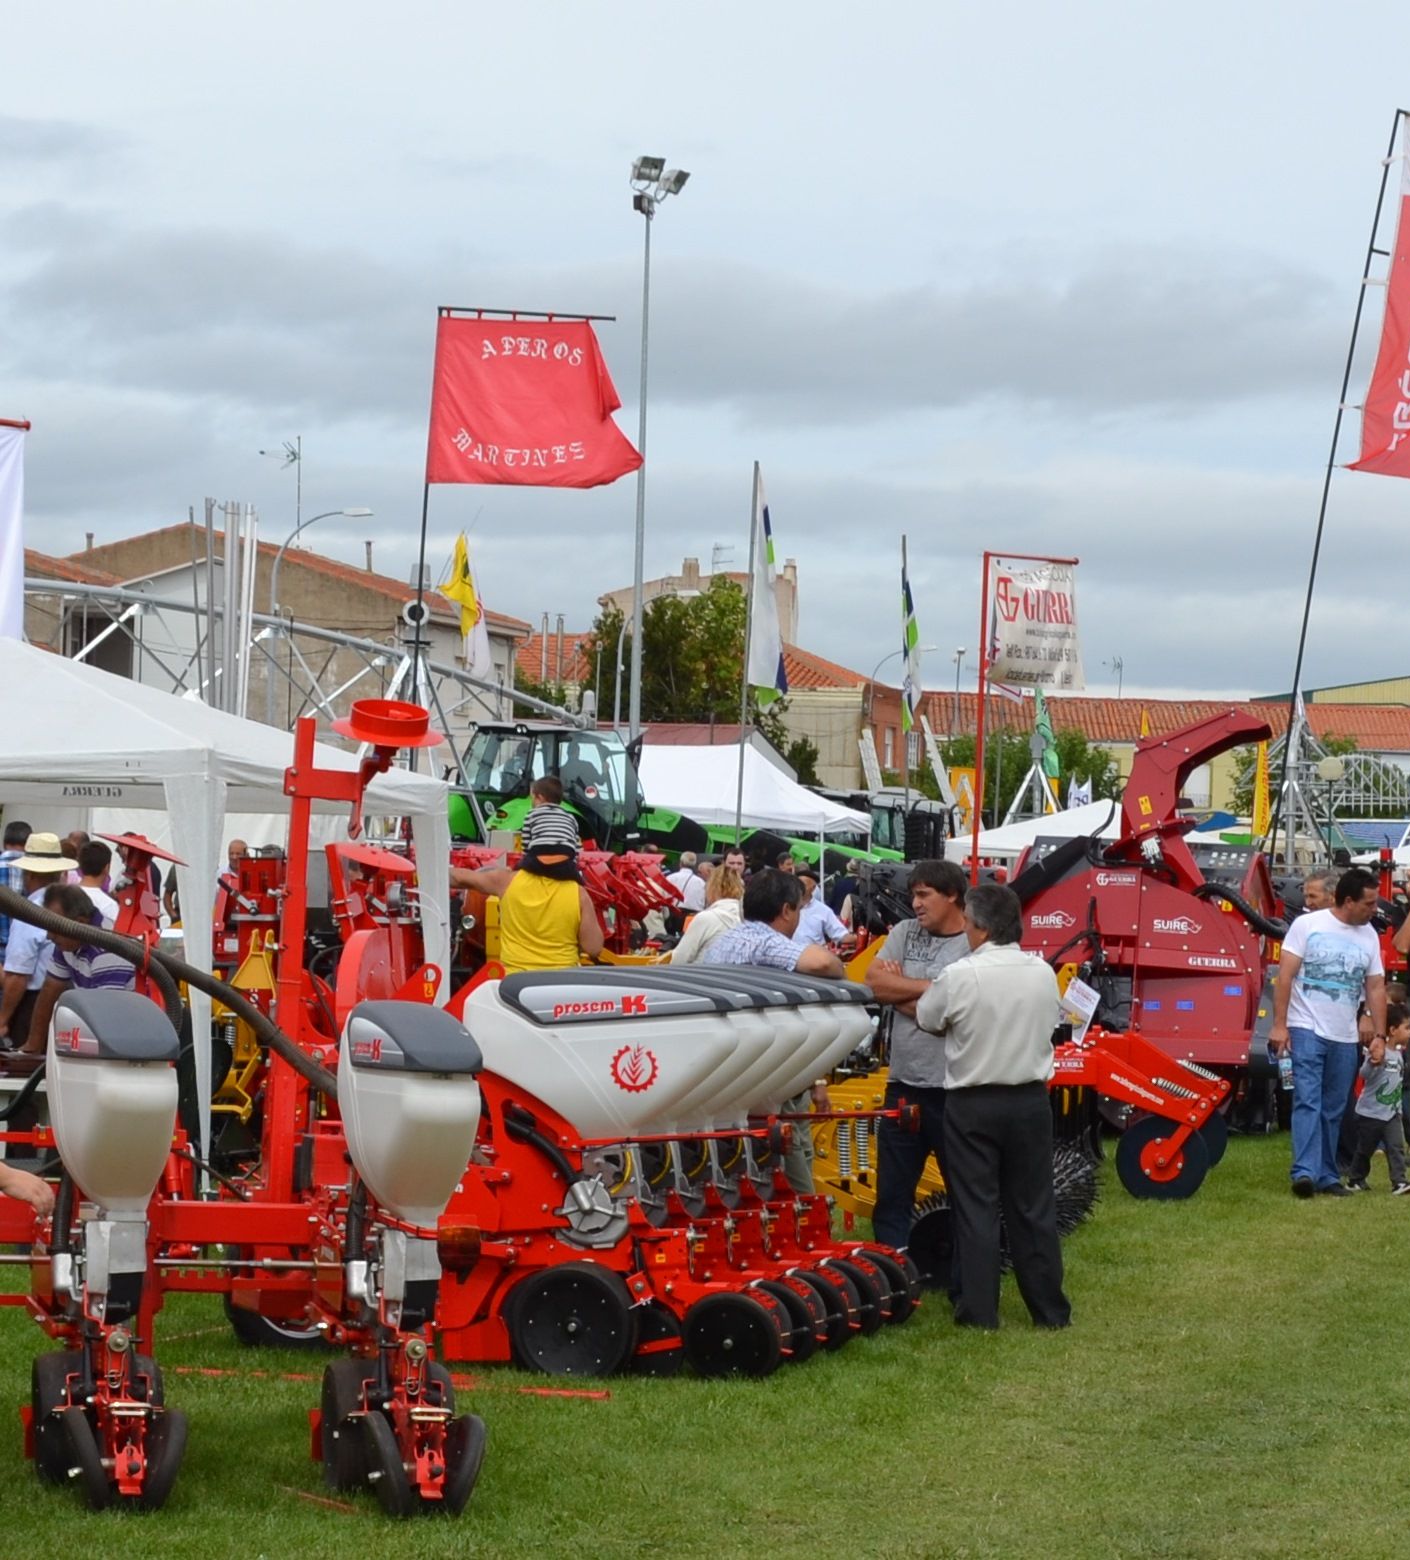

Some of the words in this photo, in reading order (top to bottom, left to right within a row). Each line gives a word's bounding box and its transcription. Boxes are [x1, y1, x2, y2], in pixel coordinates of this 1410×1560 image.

[481, 335, 585, 368] APEROS
[451, 427, 586, 468] MARTINES
[1030, 915, 1063, 926] SUIRE
[1153, 918, 1189, 932] SUIRE
[1187, 955, 1238, 969] GUERRA
[553, 1000, 615, 1020] prosem
[621, 994, 648, 1015] K
